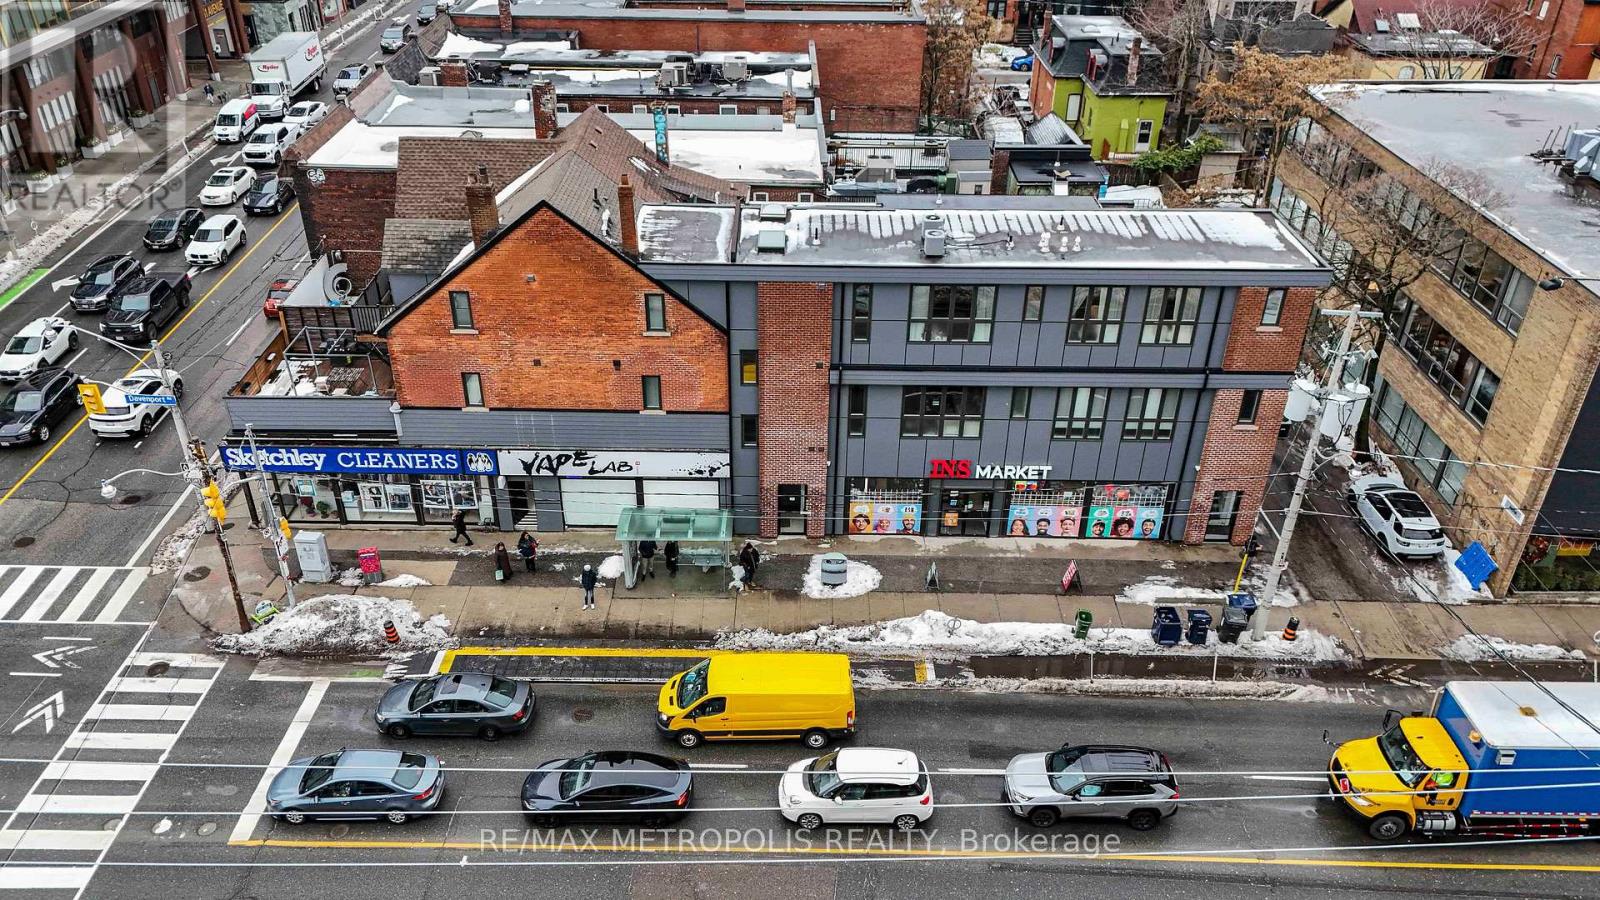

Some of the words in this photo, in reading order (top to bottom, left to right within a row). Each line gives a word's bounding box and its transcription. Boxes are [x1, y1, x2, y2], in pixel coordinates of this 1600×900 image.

[128, 395, 166, 403] Davenport
[337, 452, 459, 469] CLEANERS
[518, 450, 598, 476] VAPE
[588, 460, 633, 476] LAB
[929, 459, 972, 479] INS
[975, 464, 1053, 480] MARKET
